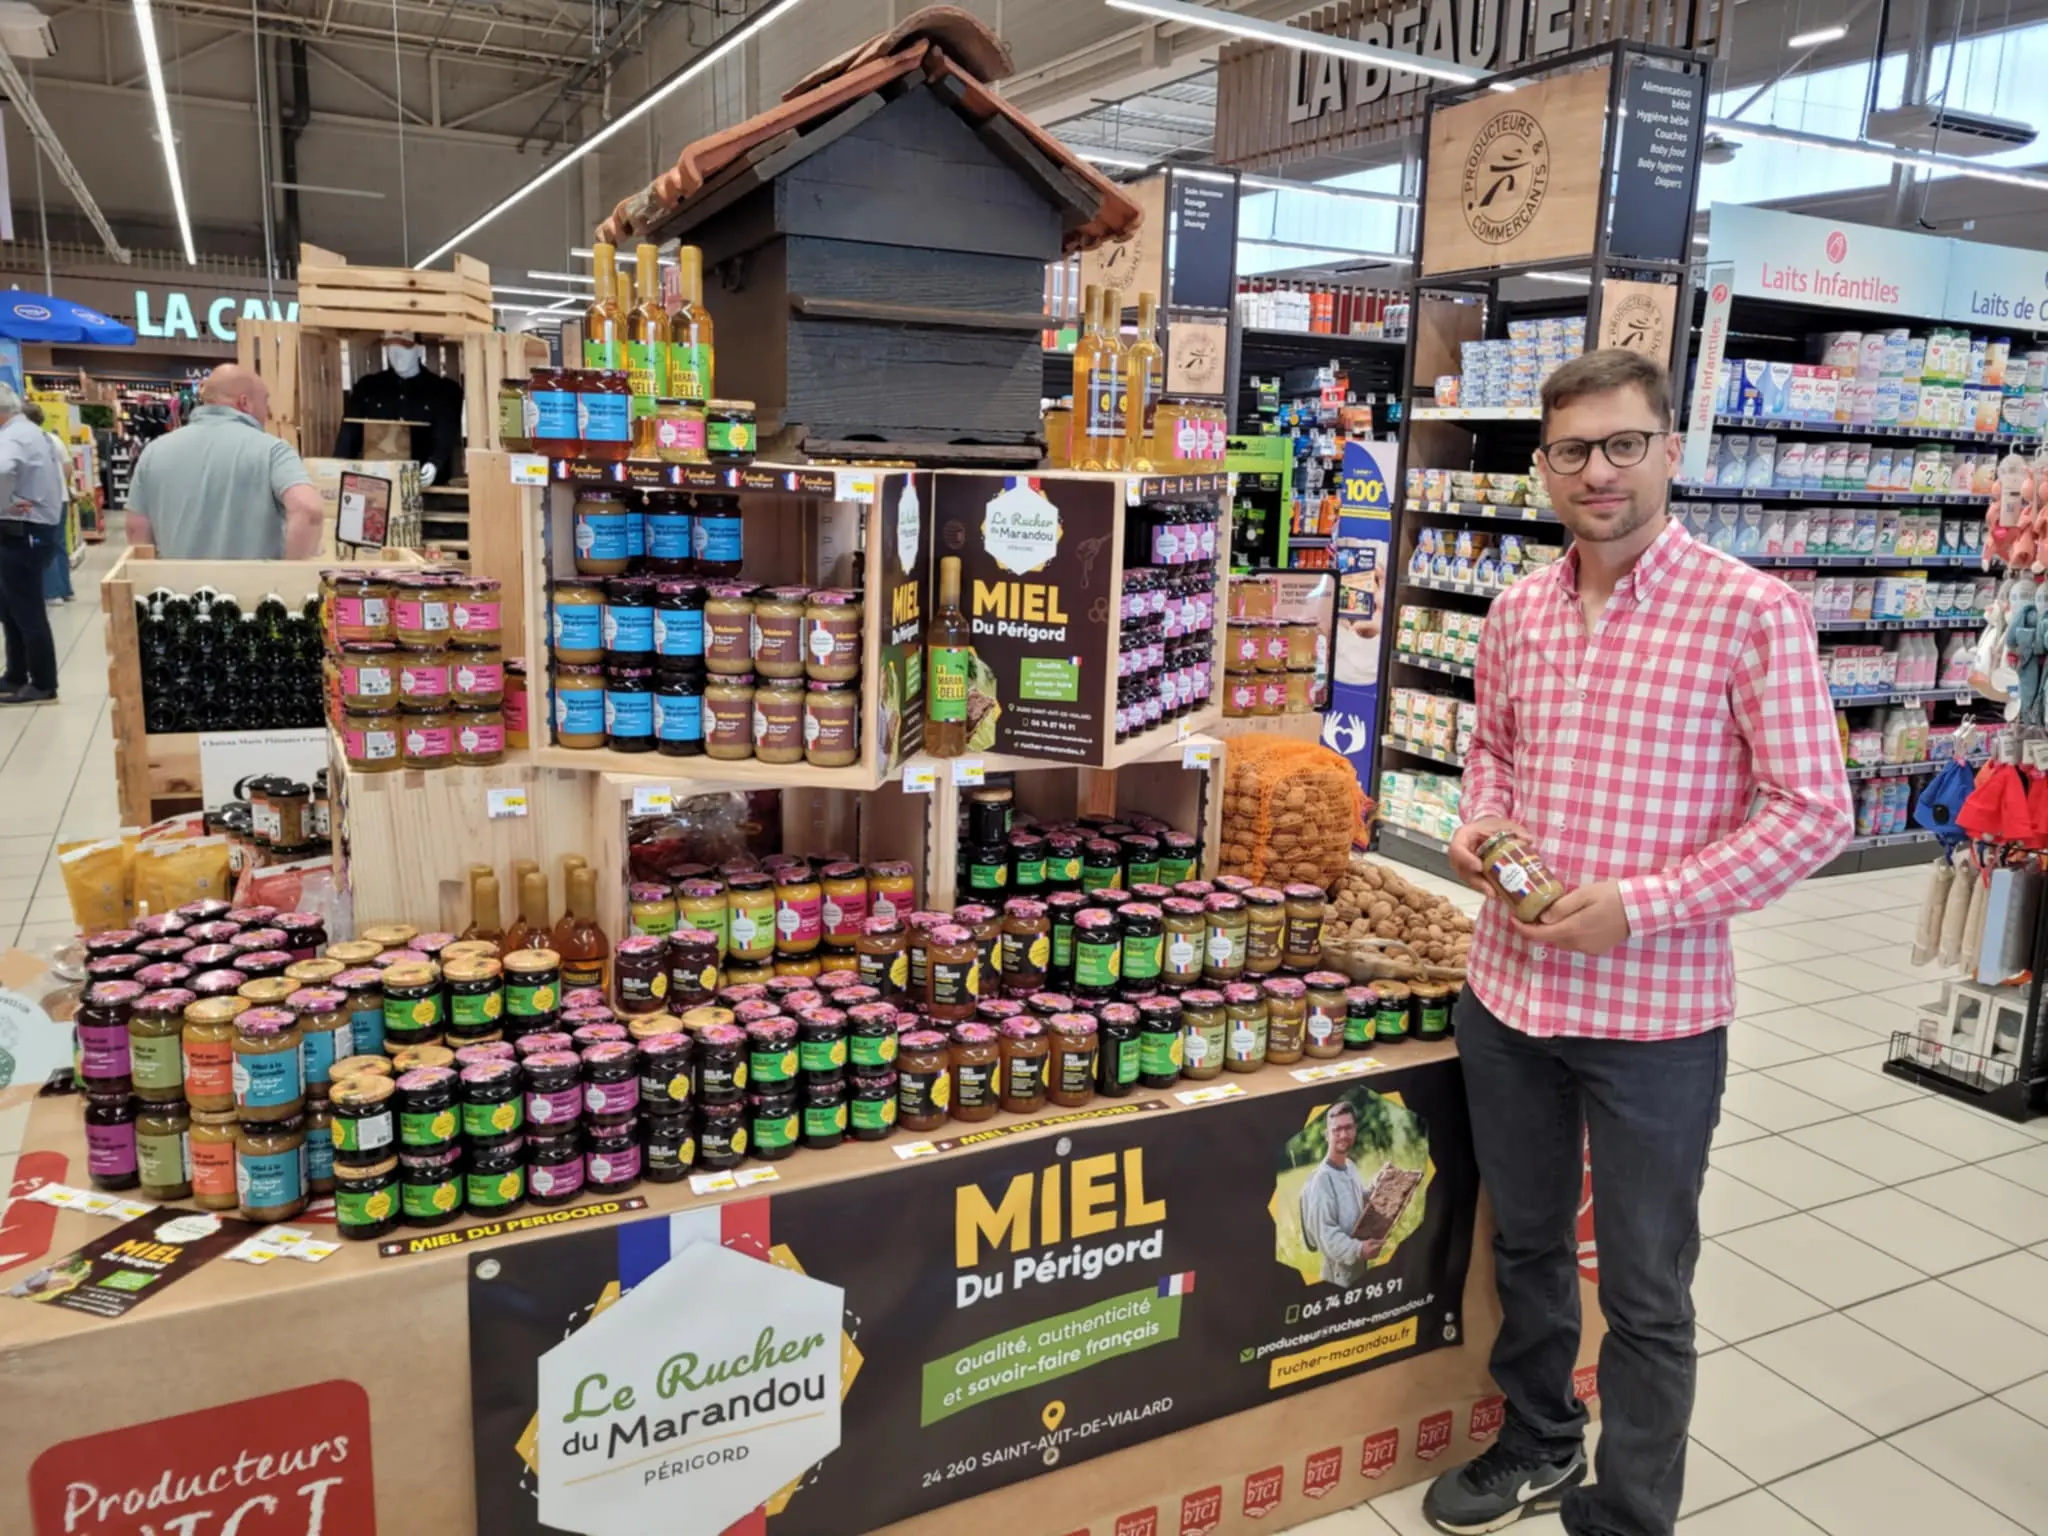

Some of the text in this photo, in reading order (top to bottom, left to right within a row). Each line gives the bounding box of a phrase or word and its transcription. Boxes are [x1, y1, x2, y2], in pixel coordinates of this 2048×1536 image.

[1288, 38, 1343, 124] LA
[1641, 81, 1692, 98] Alimentation
[1464, 114, 1535, 194] PRODUCTEURS
[1532, 139, 1545, 157] &
[1650, 144, 1687, 158] Baby food
[1654, 128, 1688, 142] Couches
[1637, 158, 1656, 172] Baby
[1654, 176, 1682, 190] Diapers
[1761, 263, 1900, 304] Laits Infantiles
[135, 290, 199, 339] LA
[1971, 289, 2009, 319] Laits
[2013, 297, 2034, 322] de
[1694, 316, 1723, 431] Laits Infantiles
[991, 511, 1054, 528] Le Rucher
[1000, 527, 1054, 542] Marandou
[892, 579, 920, 627] MIEL
[973, 579, 1069, 625] MIEL
[972, 618, 1067, 643] Du Périgord
[960, 1128, 1007, 1146] MIEL
[1007, 1121, 1040, 1135] DU
[956, 1147, 1167, 1268] MIEL
[111, 1238, 185, 1264] MIEL
[409, 1231, 463, 1253] MIEL
[466, 1224, 502, 1241] DU
[956, 1229, 1164, 1310] Du Périgord
[1302, 1278, 1404, 1319] 06 74 87 96 91
[955, 1297, 1151, 1376] Qualité, authenticité
[1276, 1326, 1411, 1377] rucher-marandou.fr
[562, 1326, 826, 1423] Le Rucher
[943, 1321, 1160, 1407] et savoir-faire français
[562, 1374, 826, 1459] du Marandou
[921, 1397, 1174, 1488] 24 260 SAINT-AVIT-DE-VIALARD
[63, 1435, 349, 1533] Producteurs
[644, 1446, 750, 1486] PÉRIGORD
